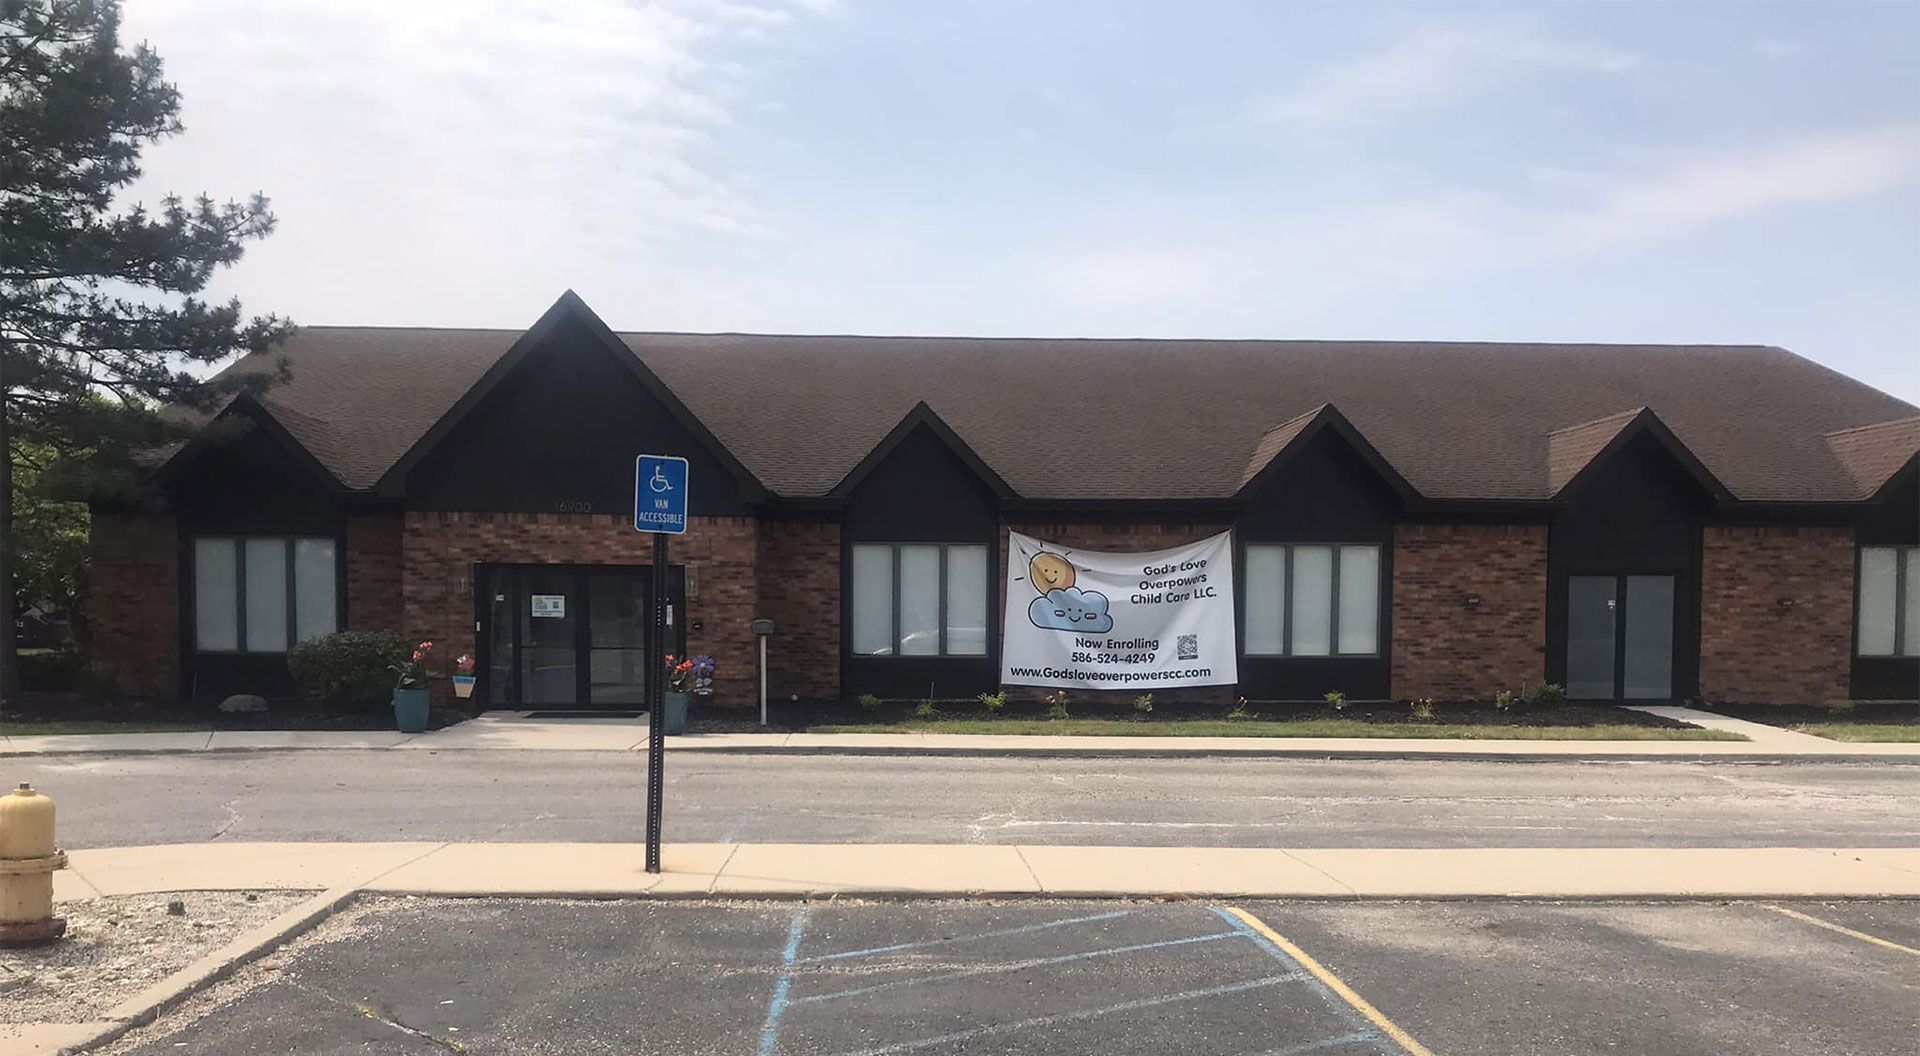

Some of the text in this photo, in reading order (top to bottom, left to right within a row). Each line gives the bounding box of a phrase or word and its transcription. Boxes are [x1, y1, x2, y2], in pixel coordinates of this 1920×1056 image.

[654, 498, 669, 509] VAN
[638, 511, 684, 525] ACCESSIBLE
[1143, 559, 1207, 576] God's Love
[1139, 573, 1208, 590] Overpowers
[1130, 586, 1217, 605] Child Care LLC.
[1075, 637, 1159, 651] Now Enrolling
[1071, 651, 1156, 665] 586-524-4249
[1010, 666, 1212, 684] www.Godsloveoverpowerscc.com
